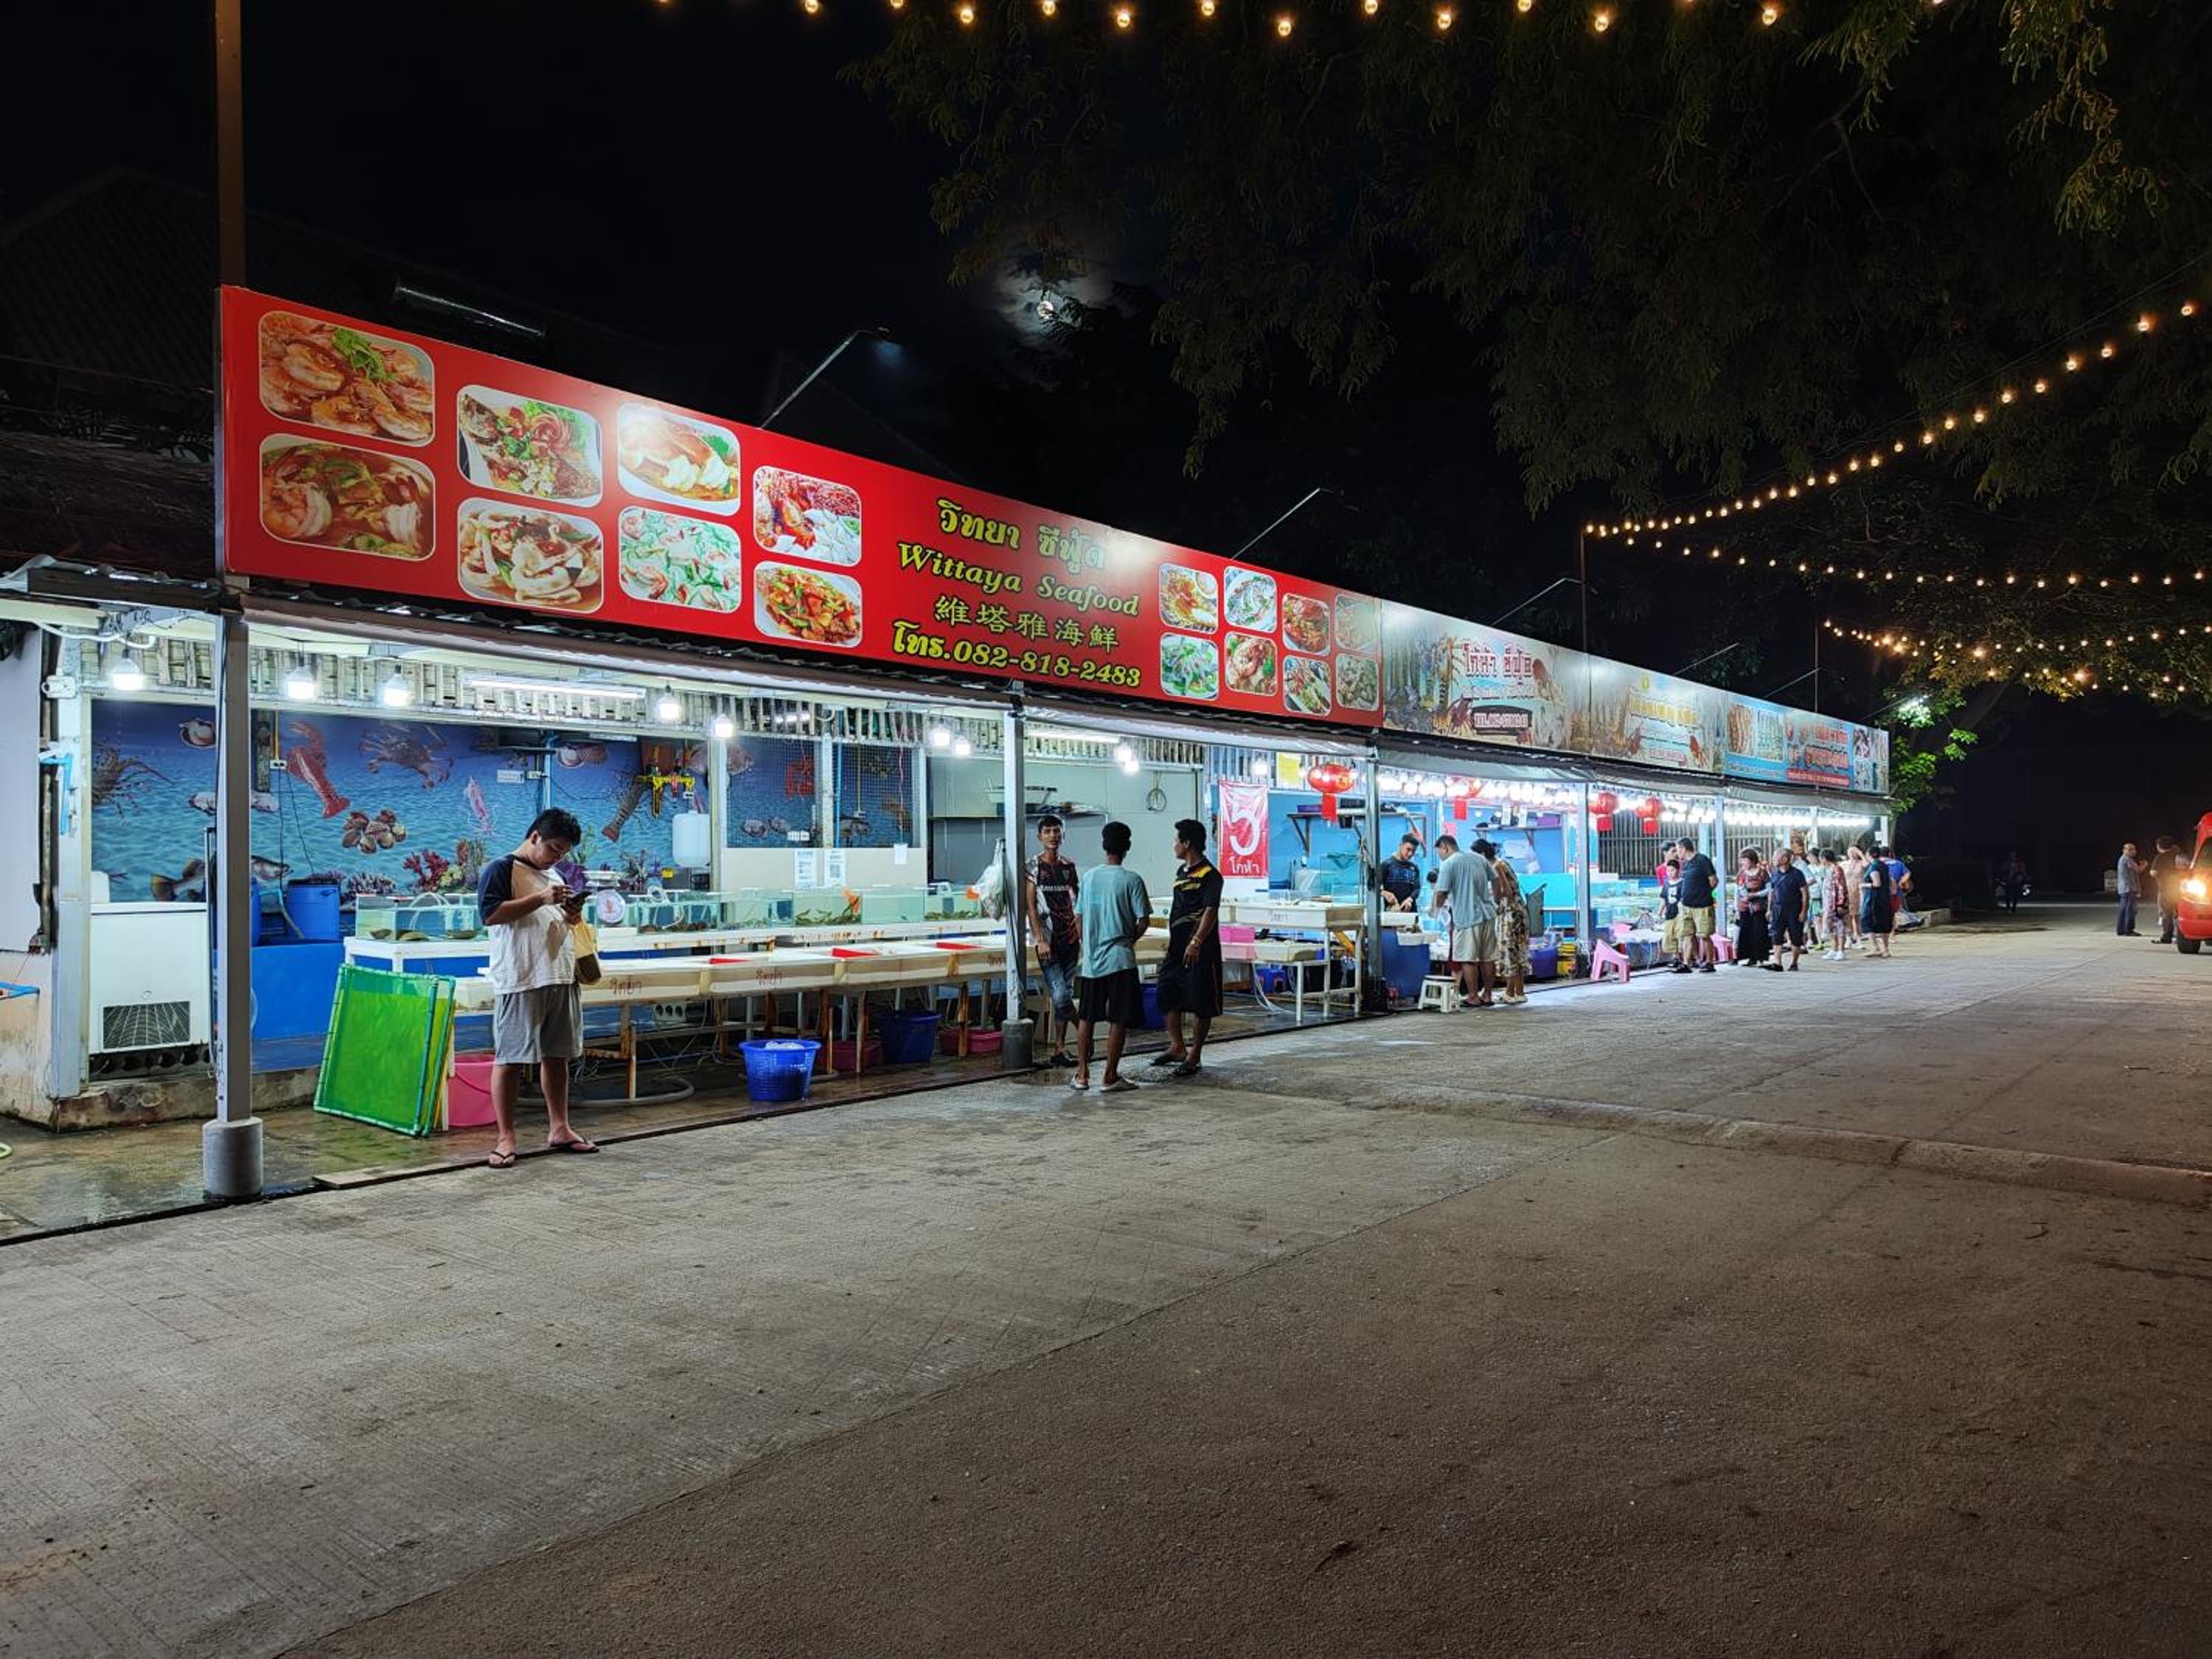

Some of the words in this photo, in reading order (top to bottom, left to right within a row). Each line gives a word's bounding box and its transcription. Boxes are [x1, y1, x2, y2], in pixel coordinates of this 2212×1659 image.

[936, 498, 1021, 550] วิทยา
[1037, 524, 1107, 574] ซีฟู้ด
[898, 543, 1023, 594] Wittaya
[1037, 575, 1140, 616] Seafood
[893, 620, 1142, 687] โทร.082-818-2483
[934, 595, 1119, 654] 維塔雅海鮮
